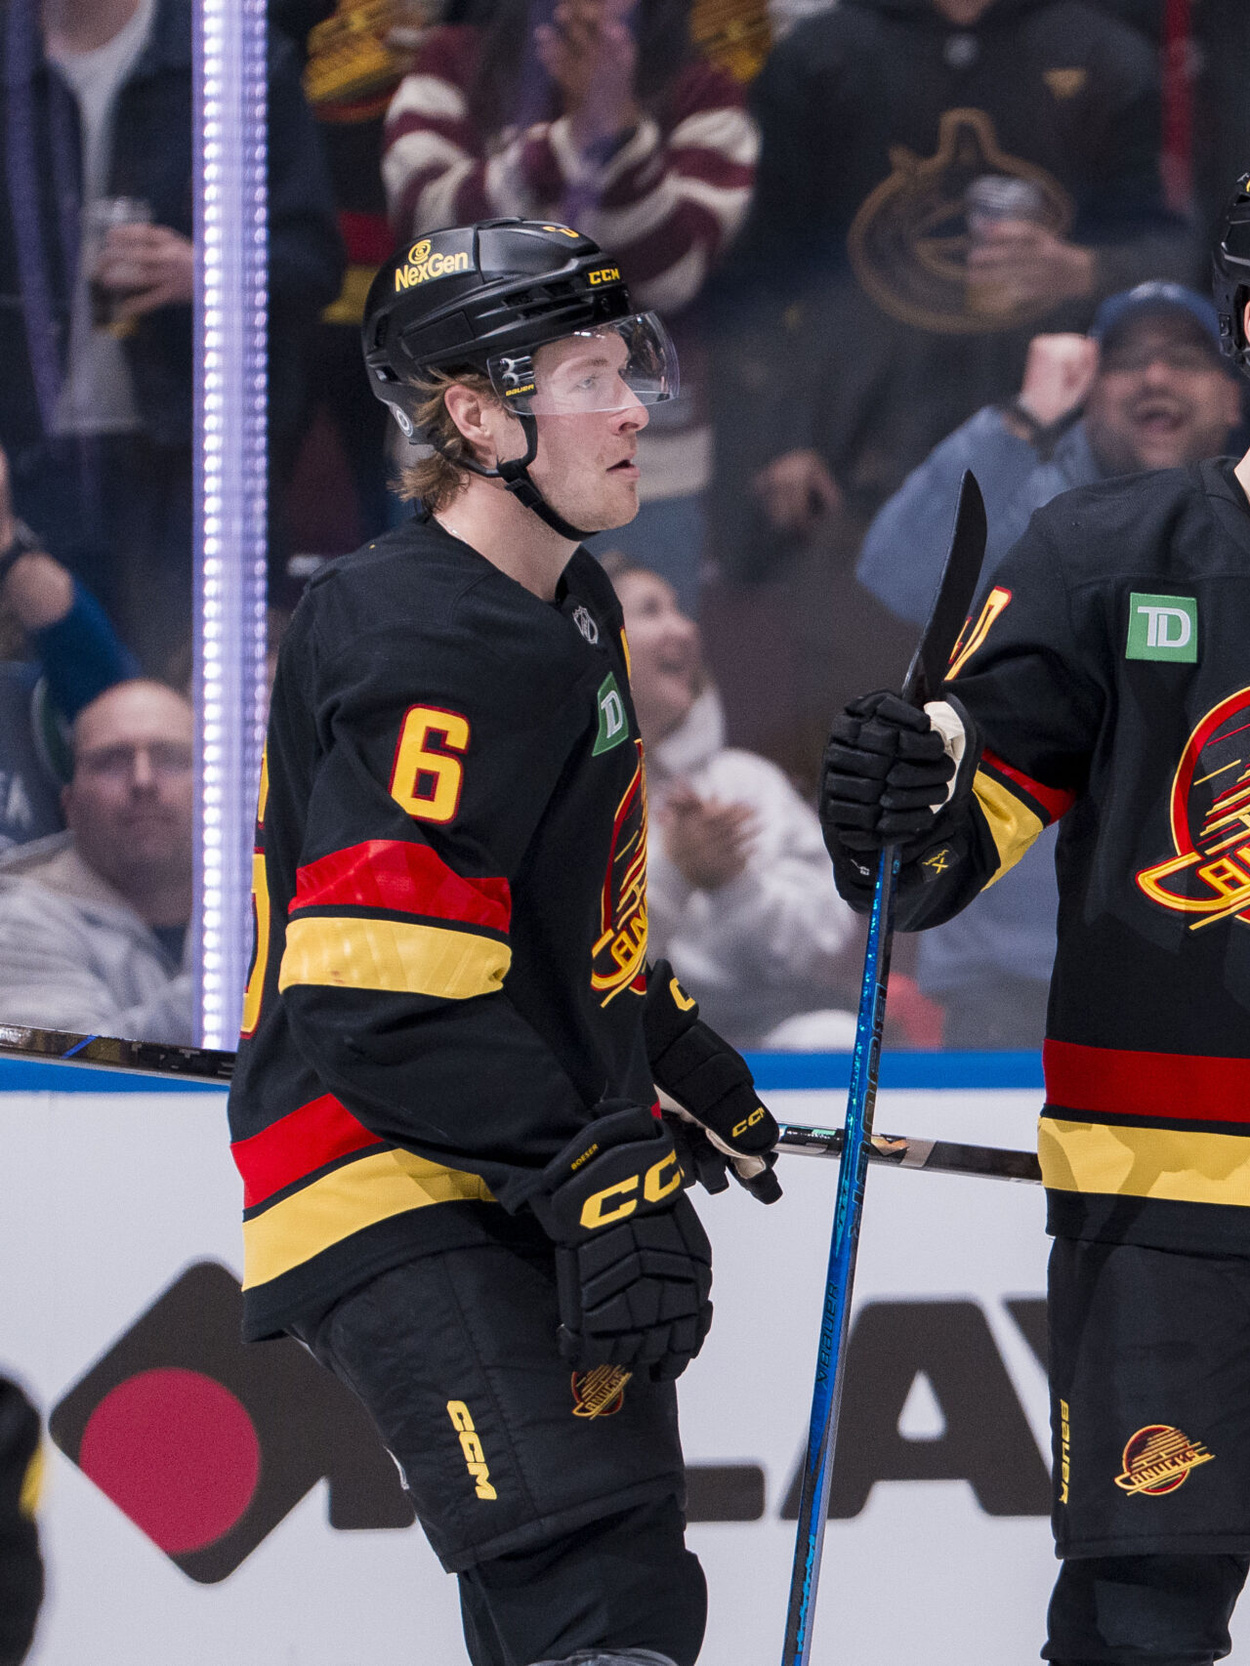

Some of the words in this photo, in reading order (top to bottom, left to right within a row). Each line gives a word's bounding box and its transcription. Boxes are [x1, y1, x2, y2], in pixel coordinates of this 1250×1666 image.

[395, 252, 469, 292] NexGen
[588, 268, 620, 285] CCM
[1136, 605, 1192, 648] TD
[389, 703, 471, 825] 6
[571, 1143, 598, 1171] BOESER
[579, 1148, 685, 1230] CC
[446, 1400, 498, 1501] CCM
[1059, 1399, 1070, 1504] BAUER
